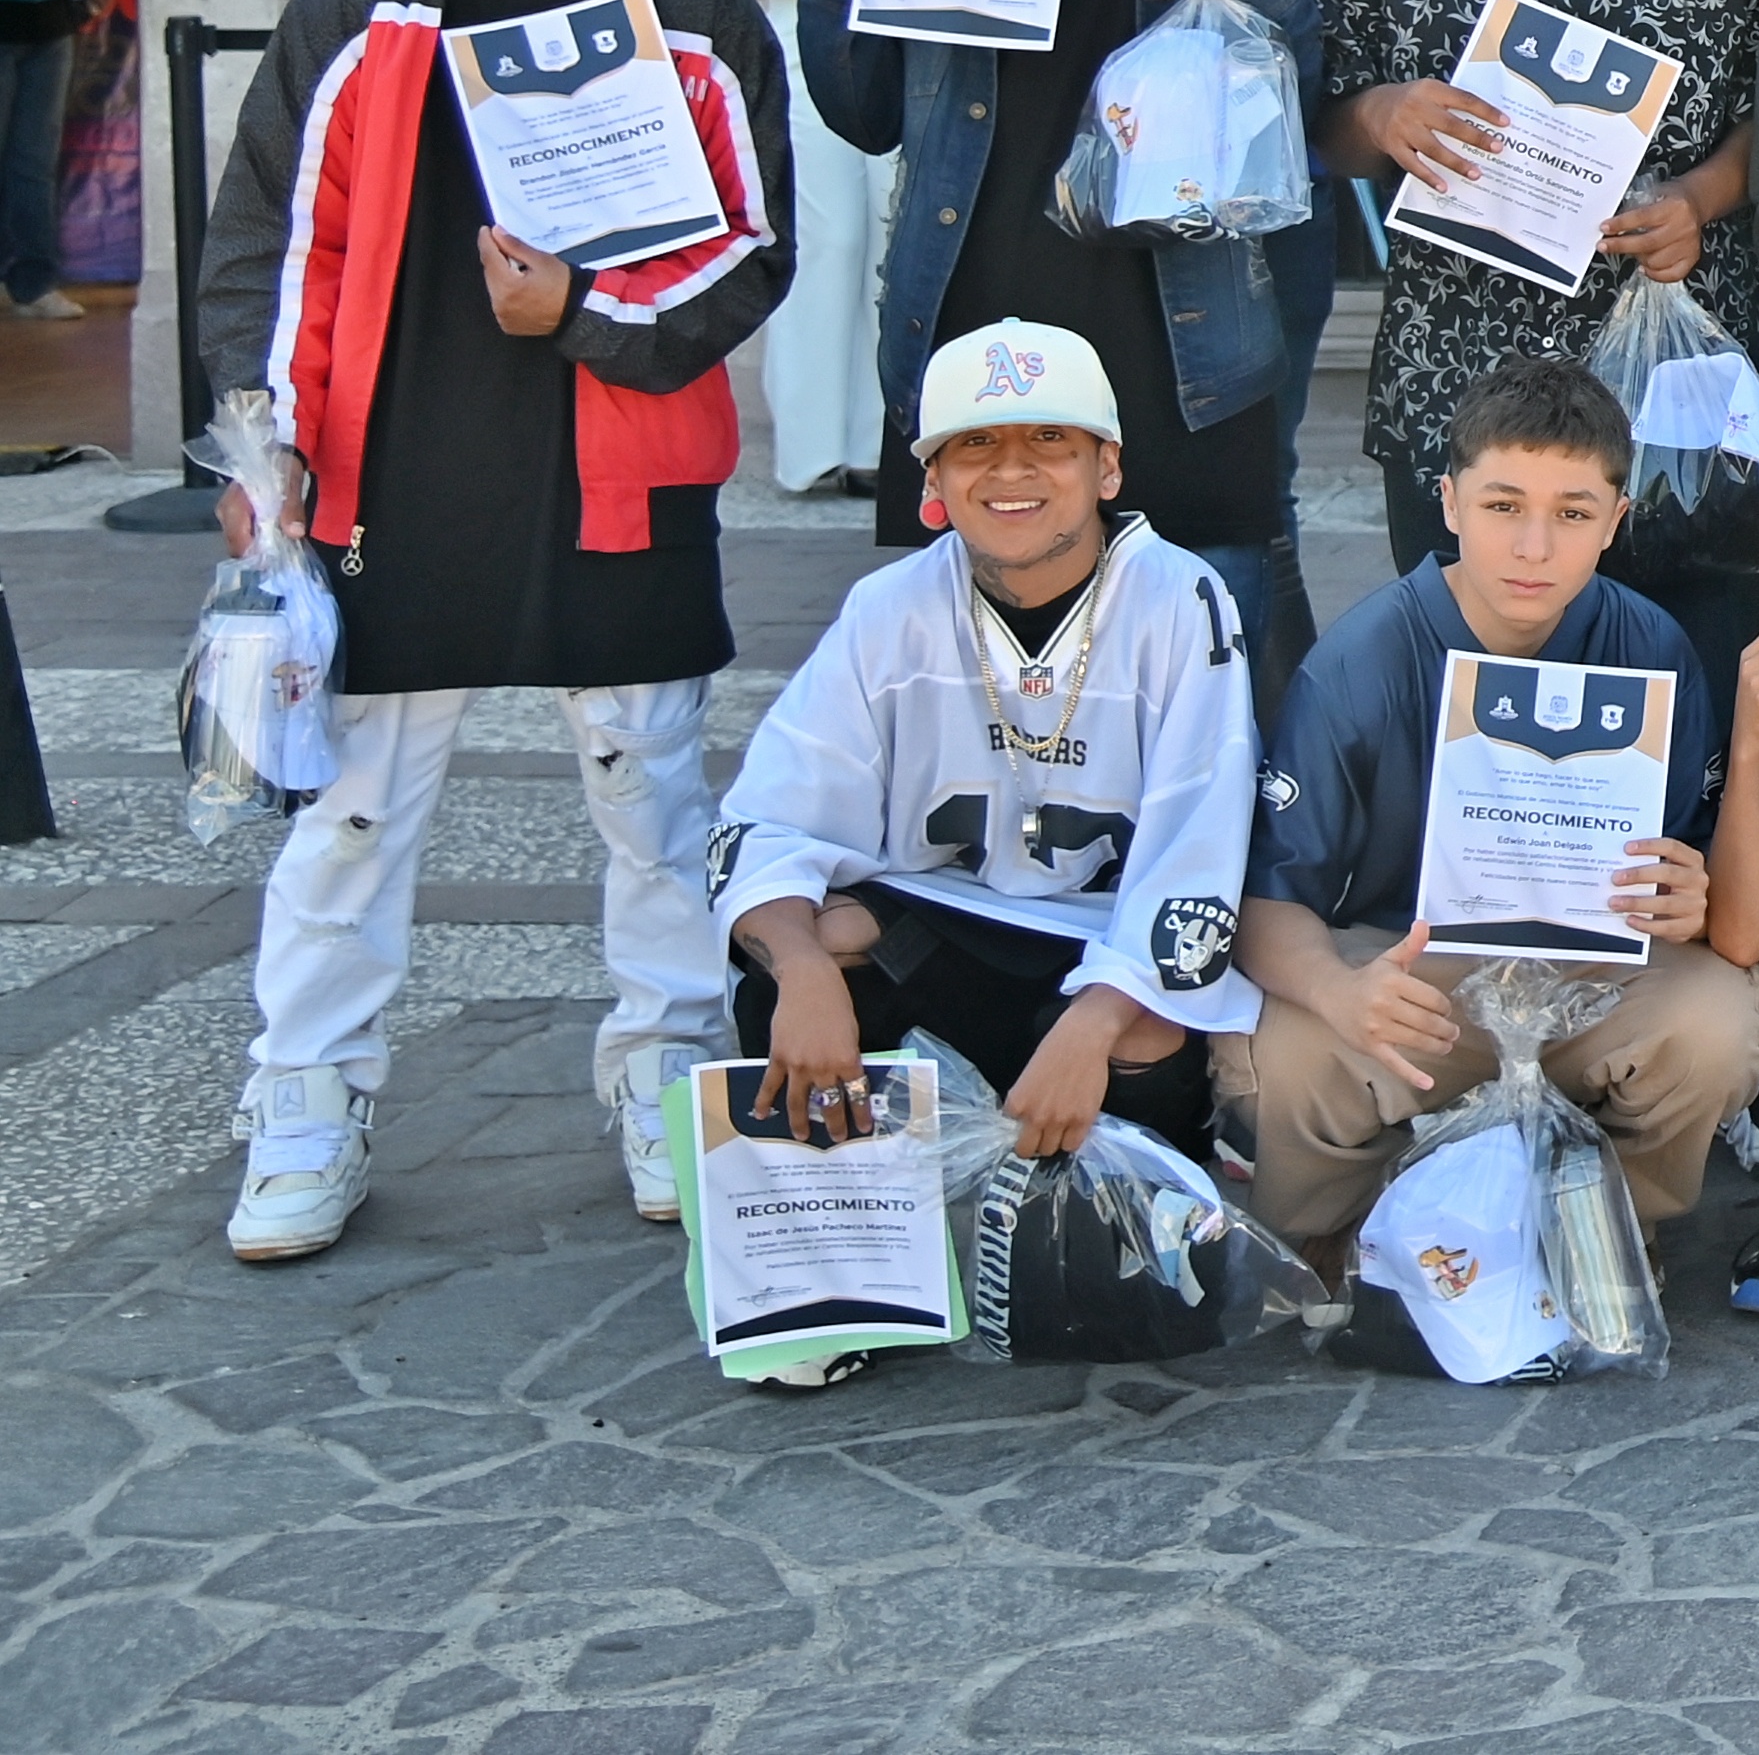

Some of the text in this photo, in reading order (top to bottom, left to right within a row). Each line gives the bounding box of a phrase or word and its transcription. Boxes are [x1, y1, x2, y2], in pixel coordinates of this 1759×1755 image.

[507, 118, 665, 169] RECONOCIMIENTO
[1021, 678, 1051, 695] NFL
[988, 723, 1087, 767] RADERS
[1461, 805, 1633, 833] RECONOCIMIENTO
[1528, 838, 1551, 847] Joan
[1553, 839, 1593, 851] Delgado
[735, 1198, 915, 1220] RECONOCIMIENTO
